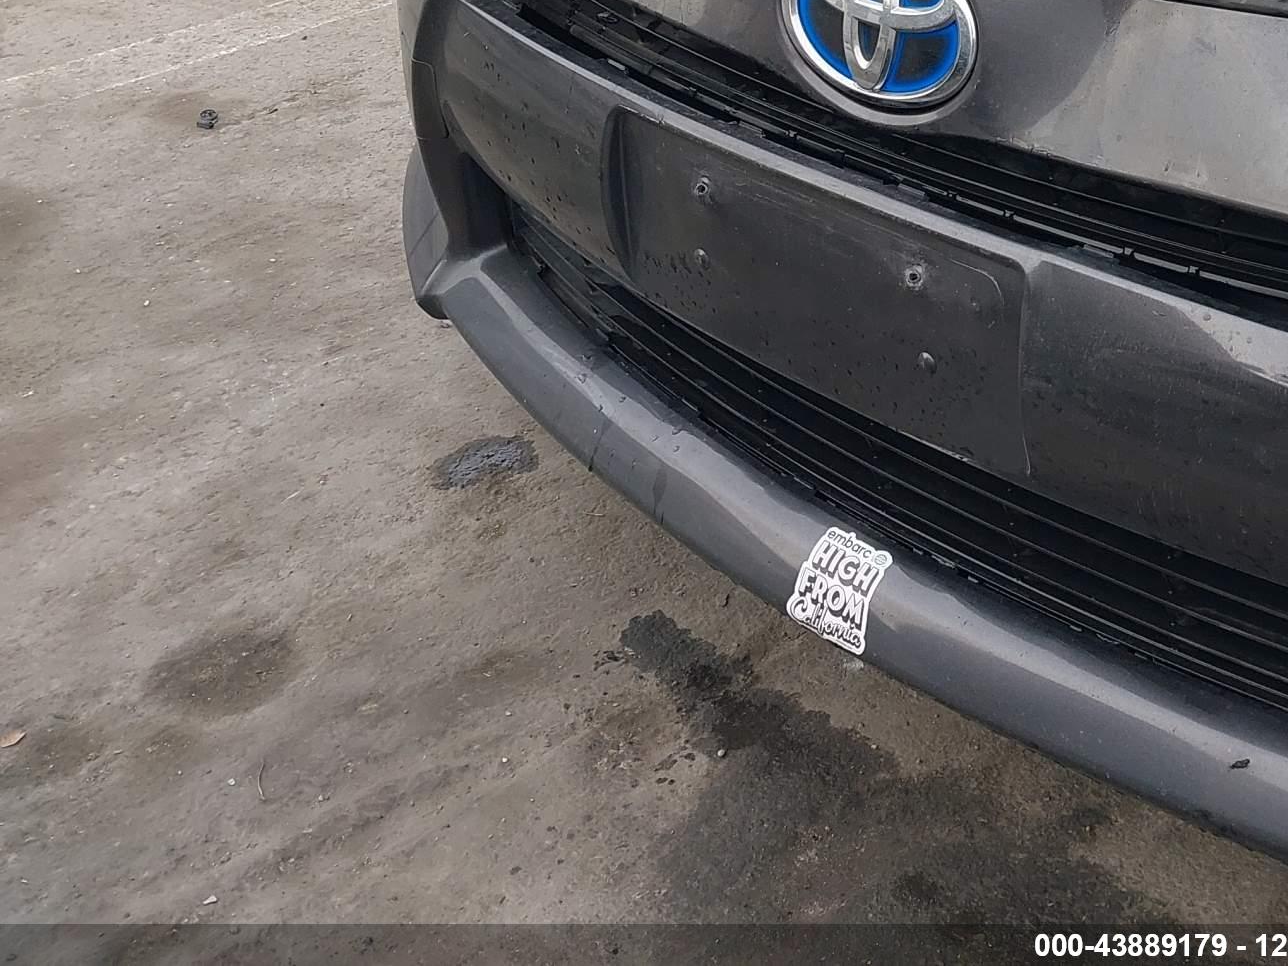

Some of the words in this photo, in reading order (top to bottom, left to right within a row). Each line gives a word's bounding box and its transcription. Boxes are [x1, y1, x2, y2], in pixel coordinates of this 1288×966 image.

[812, 541, 879, 597] HIGH
[828, 530, 872, 559] embarc
[792, 597, 862, 649] California
[798, 568, 865, 632] FROM
